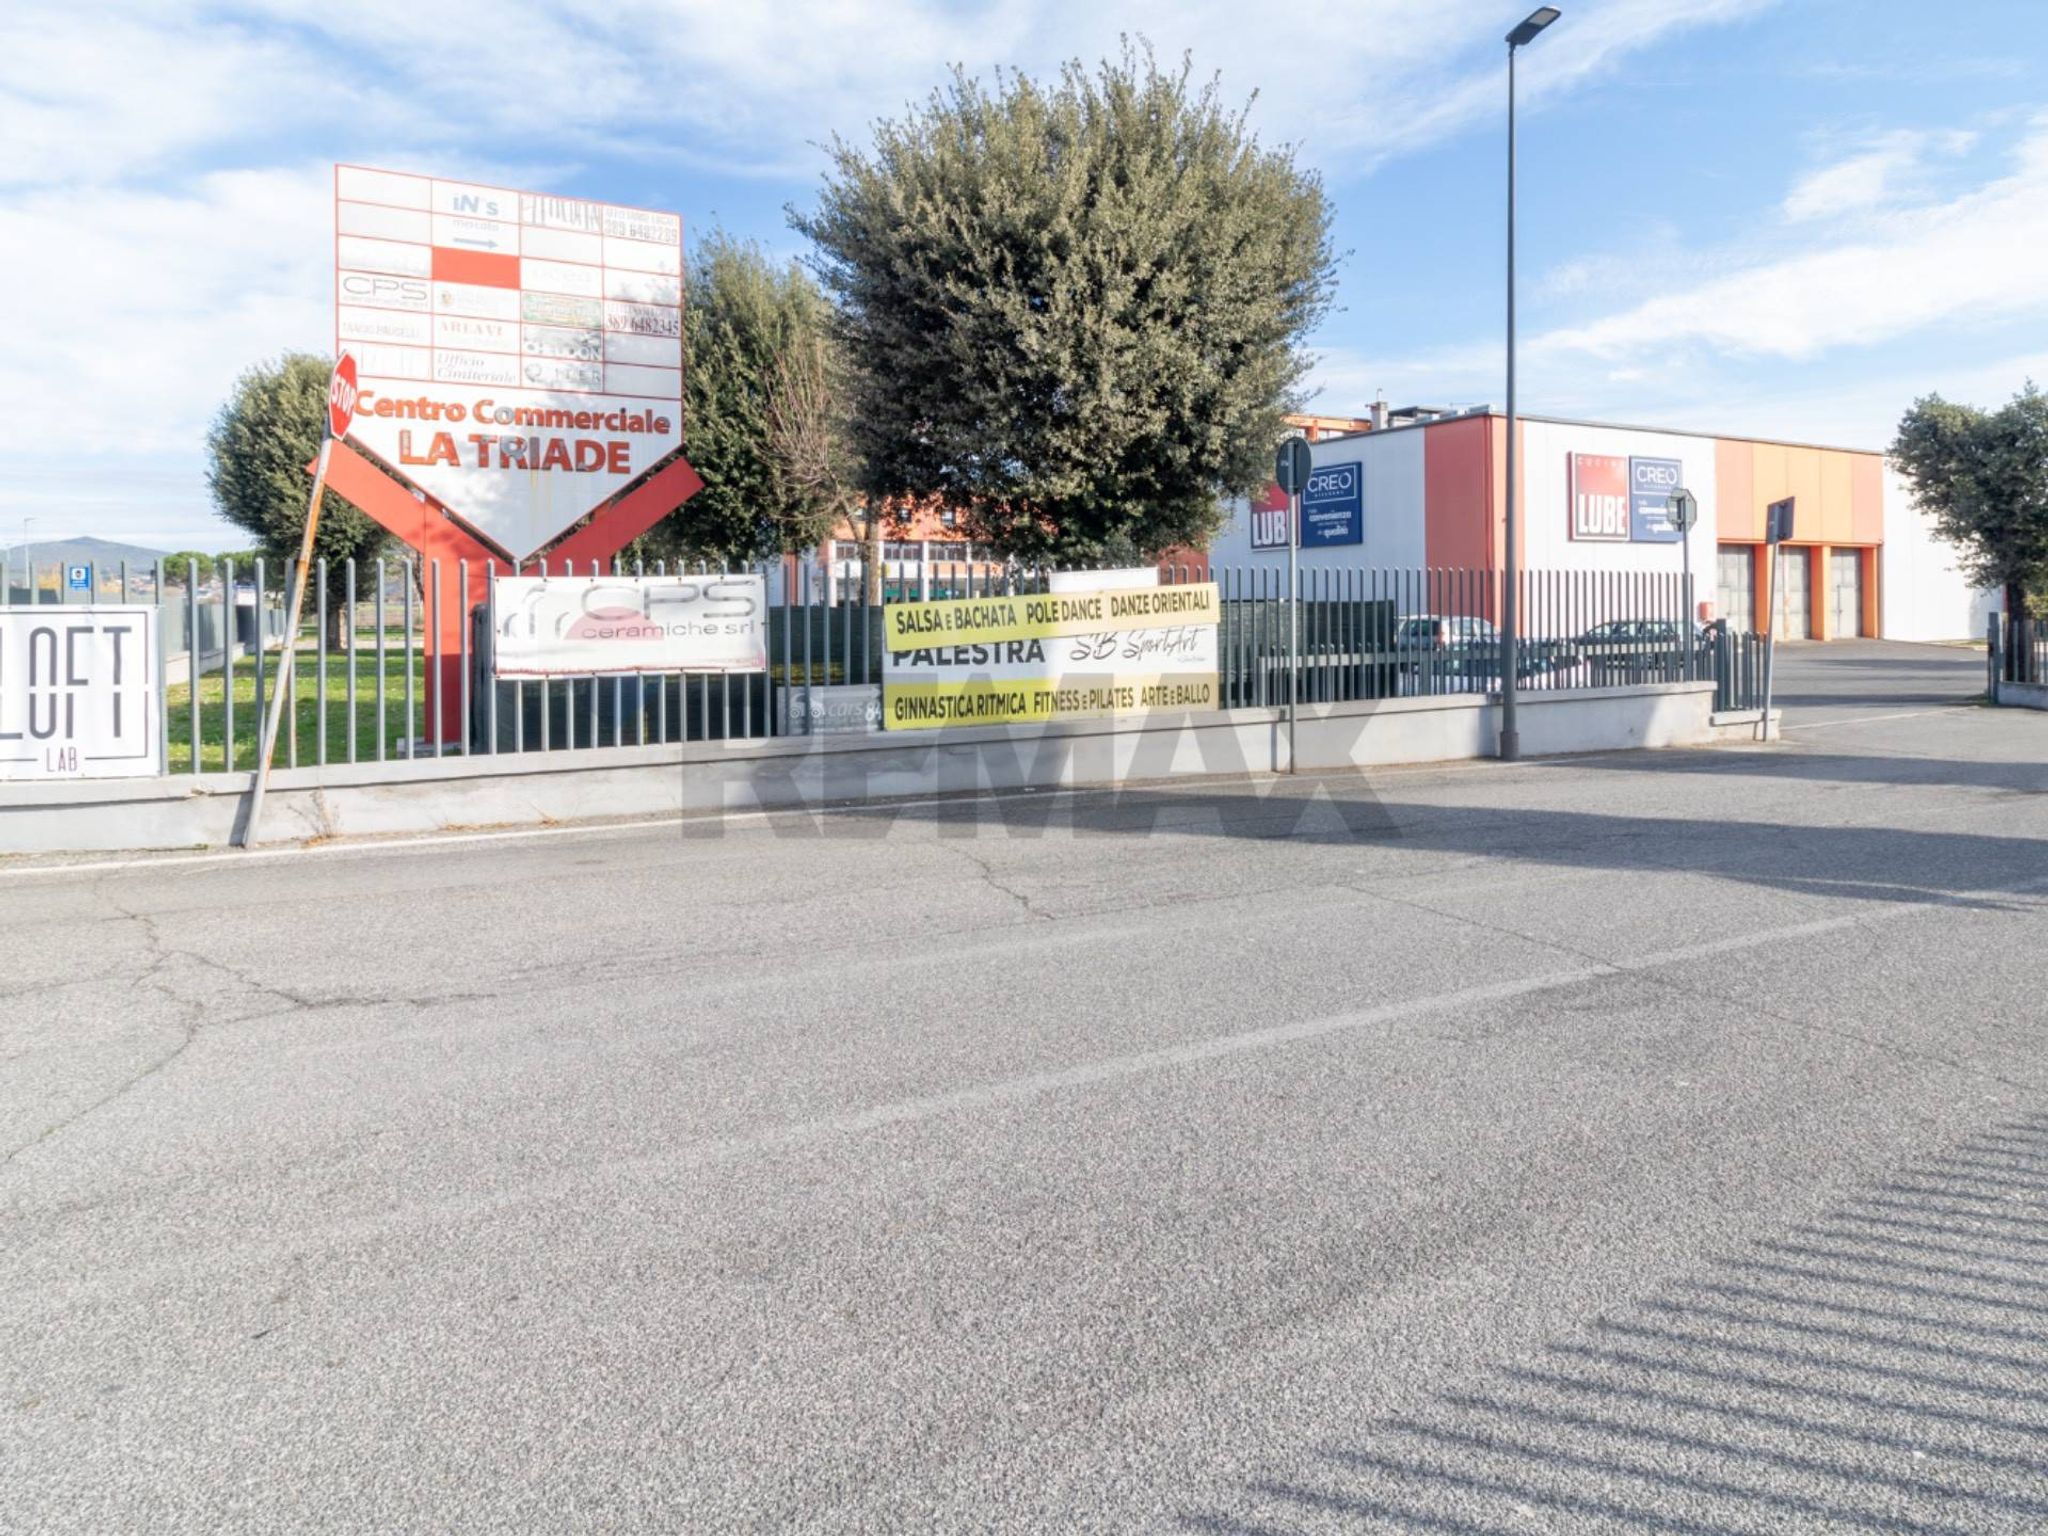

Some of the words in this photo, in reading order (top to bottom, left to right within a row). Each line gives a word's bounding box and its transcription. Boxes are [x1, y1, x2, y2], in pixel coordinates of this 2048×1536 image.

[343, 276, 428, 300] CPS
[331, 374, 356, 416] STOP
[355, 391, 466, 422] Centro
[472, 400, 670, 433] Commerciale
[399, 430, 460, 467] LA
[468, 434, 630, 474] TRIADE
[1308, 472, 1352, 492] CREO
[1637, 466, 1678, 485] CREO
[1578, 494, 1626, 534] LUBE
[581, 581, 756, 620] CPS
[896, 609, 943, 634] SALSA
[946, 614, 952, 630] E
[954, 604, 1017, 629] BACHATA
[1026, 601, 1059, 624] POLE
[1061, 598, 1103, 622] DANCE
[1110, 593, 1150, 617] DANZE
[1152, 589, 1210, 613] ORIENTALI
[582, 621, 718, 638] ceramiche
[724, 620, 754, 634] srl
[893, 638, 1046, 667] PALESTRA
[0, 626, 132, 739] LOFT
[894, 694, 977, 721] GINNASTICA
[977, 693, 1027, 717] RITMICA
[1034, 689, 1080, 713] FITNESS
[1089, 687, 1134, 710] PILATES
[1140, 686, 1168, 707] ARTE
[1177, 683, 1211, 704] BALLO
[46, 747, 77, 772] LAB
